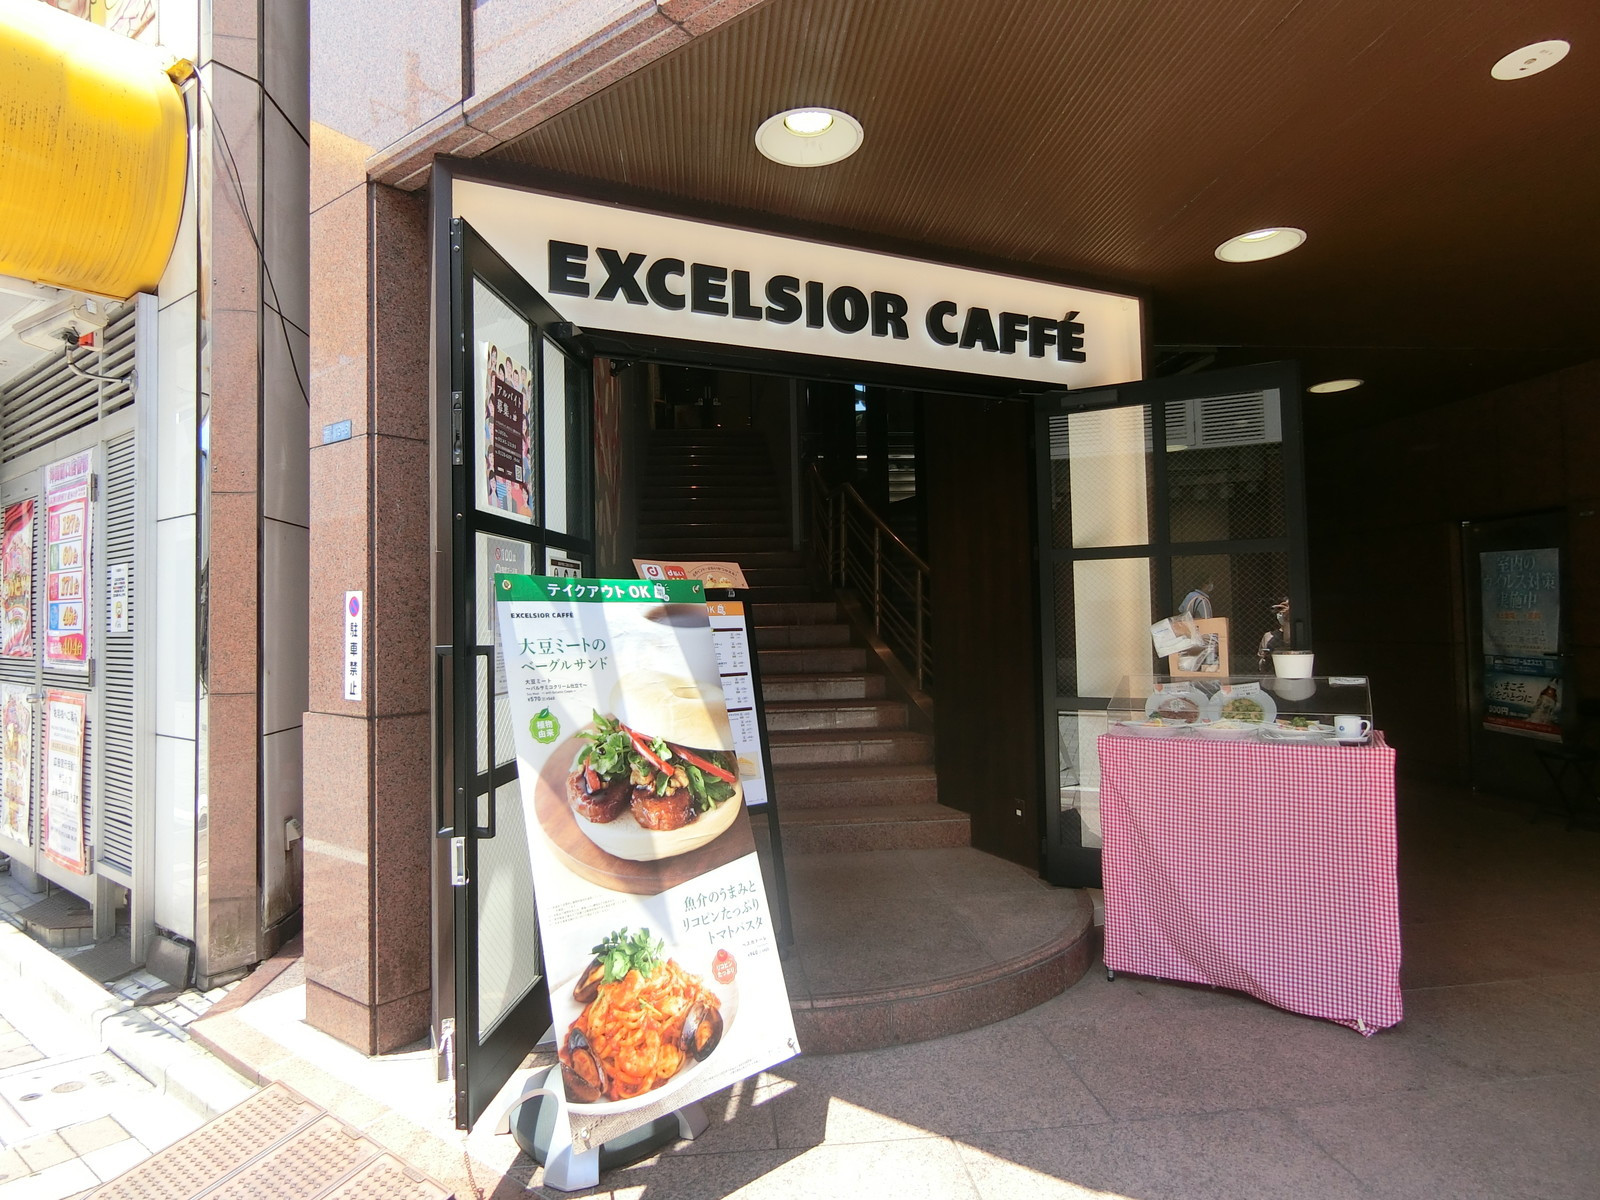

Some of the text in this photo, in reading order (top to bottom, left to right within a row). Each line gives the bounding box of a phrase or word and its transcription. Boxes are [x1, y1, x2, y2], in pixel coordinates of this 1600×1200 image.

[548, 239, 1087, 363] EXCELSIOR CAFFÉ
[497, 385, 521, 408] アルバイト
[1498, 555, 1536, 572] 室内の
[547, 583, 651, 599] テイクアウト OK
[1498, 591, 1537, 609] 実施中
[552, 611, 574, 619] CAFFÉ
[518, 637, 606, 655] 大豆ミートの
[350, 622, 358, 695] 駐車禁止
[521, 656, 608, 672] ベーグルサンド
[536, 720, 553, 729] 植物
[538, 729, 555, 739] 由来
[684, 880, 756, 912] 魚介のうまみと
[682, 898, 759, 932] リコピンたっぷり
[708, 916, 763, 944] トマトパスタ
[717, 960, 733, 970] リコピン
[717, 967, 735, 978] たっぷり
